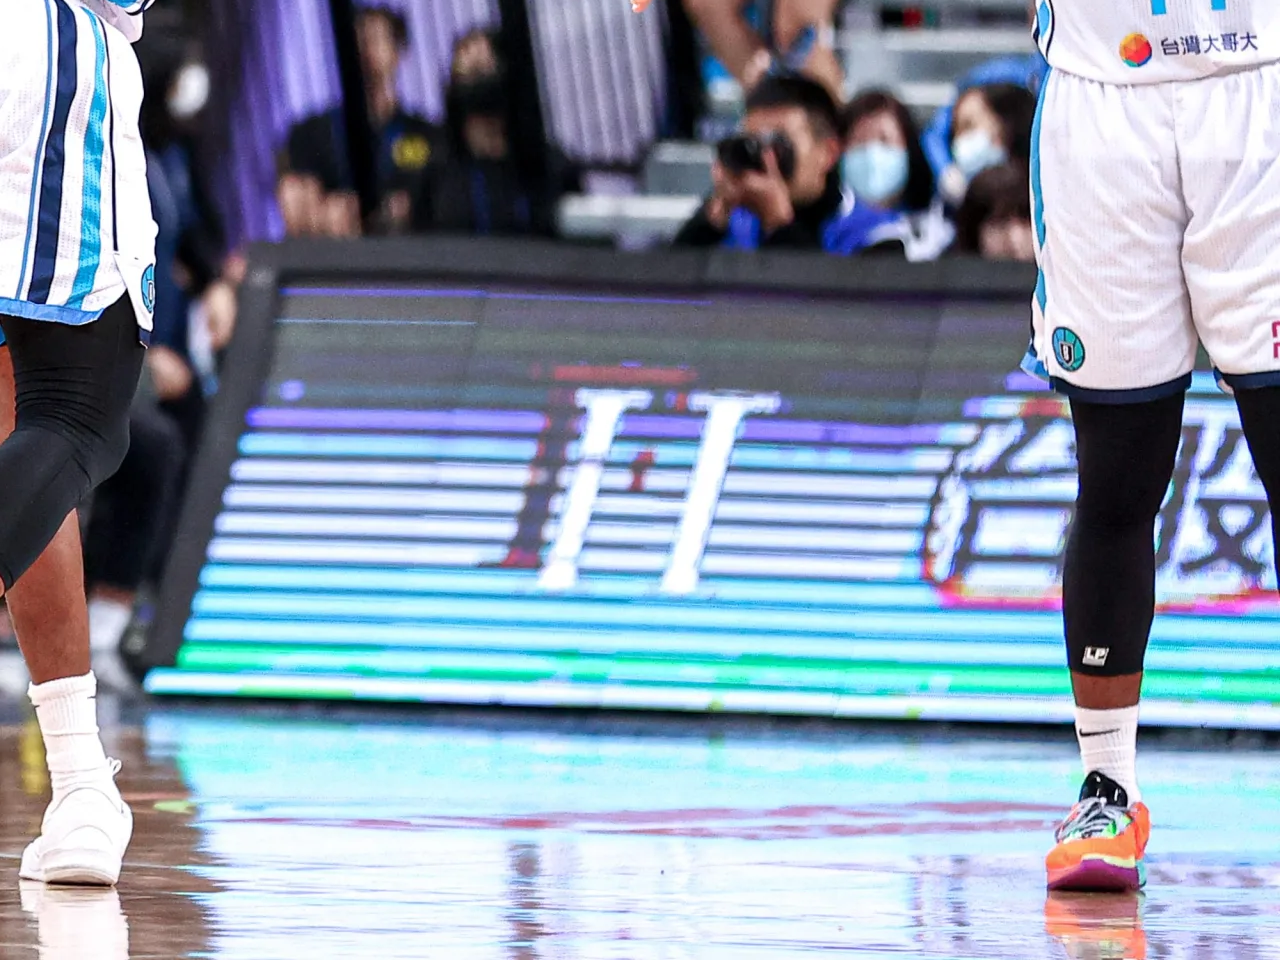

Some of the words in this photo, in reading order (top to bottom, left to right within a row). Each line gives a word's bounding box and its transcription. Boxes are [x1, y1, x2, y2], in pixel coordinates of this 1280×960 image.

[1160, 31, 1258, 56] 台灣大哥大
